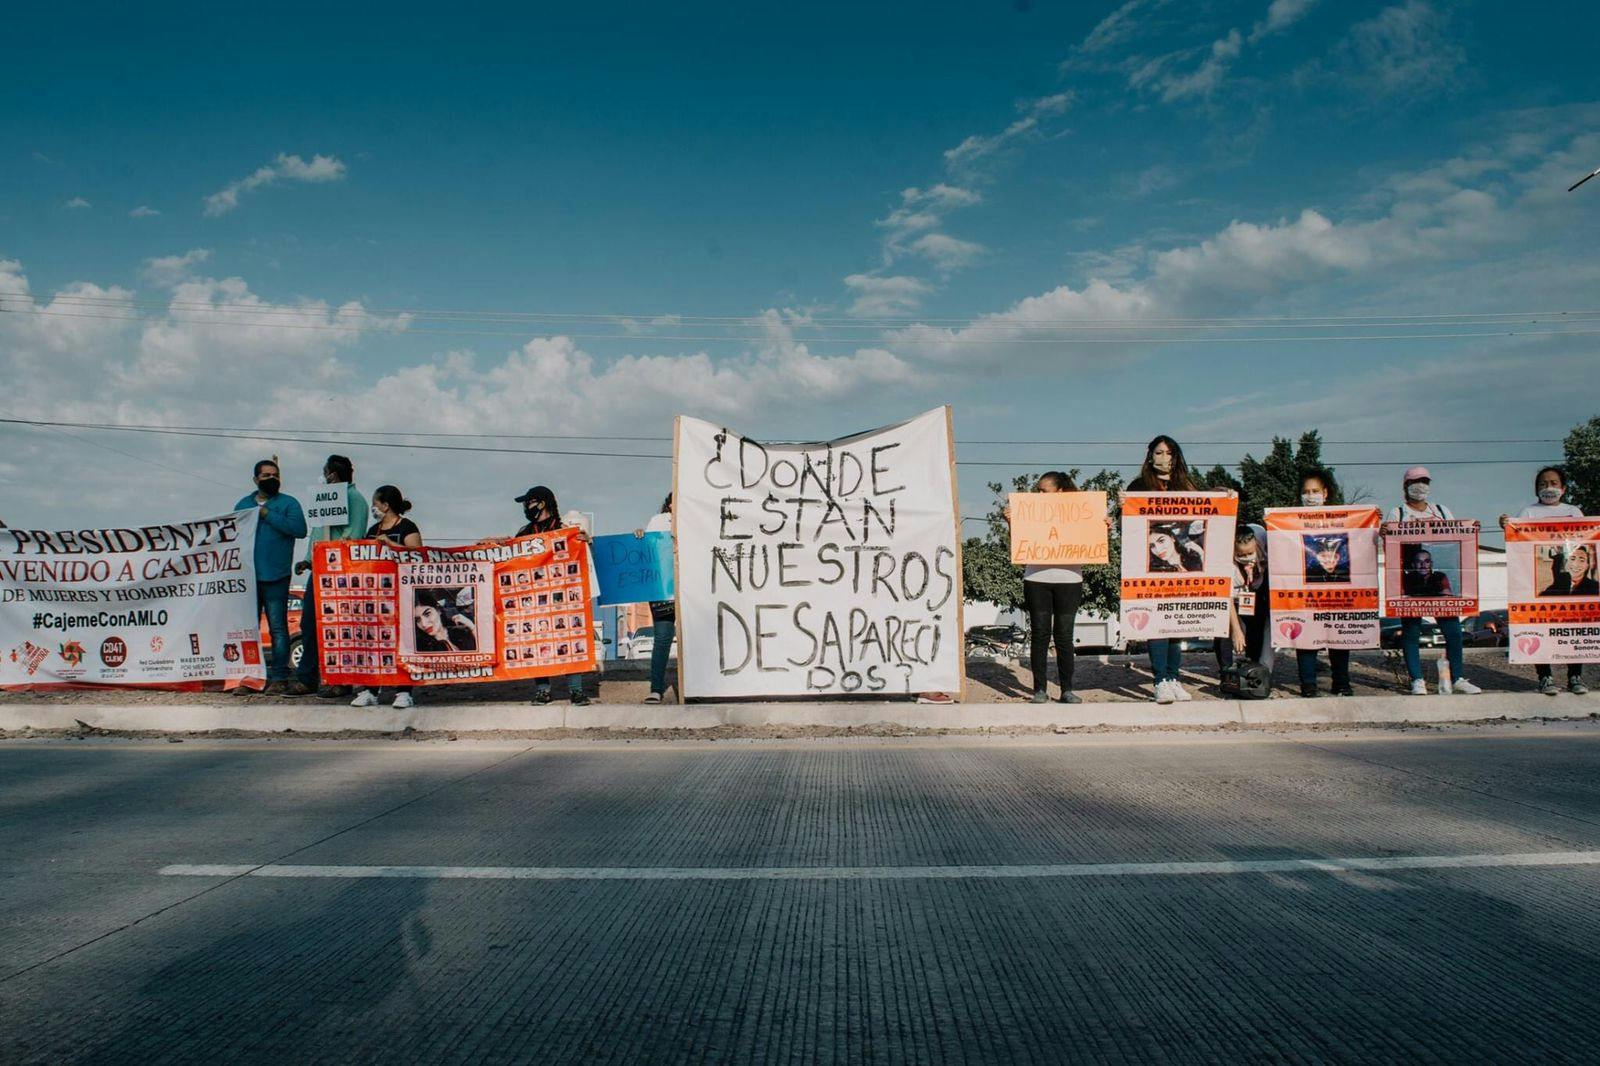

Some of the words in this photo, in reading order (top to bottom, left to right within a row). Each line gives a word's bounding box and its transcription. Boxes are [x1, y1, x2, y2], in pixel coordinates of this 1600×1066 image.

[315, 492, 338, 502] AMLO
[1147, 497, 1212, 505] FERNANDA
[308, 509, 318, 518] SE
[320, 506, 348, 517] QUEDA
[1139, 506, 1188, 516] SAÑUDO
[1192, 506, 1219, 515] LIRA
[718, 496, 896, 543] ESTAN
[8, 517, 239, 554] PRESIDENTE
[1048, 526, 1059, 540] A
[349, 544, 424, 564] ENLACES
[427, 537, 546, 563] NACIONALES
[0, 560, 111, 583] VENIDO
[116, 559, 136, 581] A
[142, 547, 242, 580] CAJEME
[410, 563, 479, 575] FERNANDA
[457, 573, 486, 584] LIRA
[710, 542, 955, 611] NUESTROS
[1123, 578, 1226, 588] DESAPARECIDO
[2, 588, 25, 603] DE
[28, 589, 99, 602] MUJERES
[99, 589, 112, 602] Y
[115, 582, 195, 602] HOMBRES
[198, 578, 248, 597] LIBRES
[1278, 590, 1379, 598] DESAPARECIDO
[1156, 602, 1228, 612] RASTREADORAS
[32, 608, 168, 632] #CajemeConAMLO
[1313, 611, 1379, 621] RASTREADORAS
[716, 600, 943, 676] DESAPARECI
[400, 654, 492, 664] DESAPARECIDO
